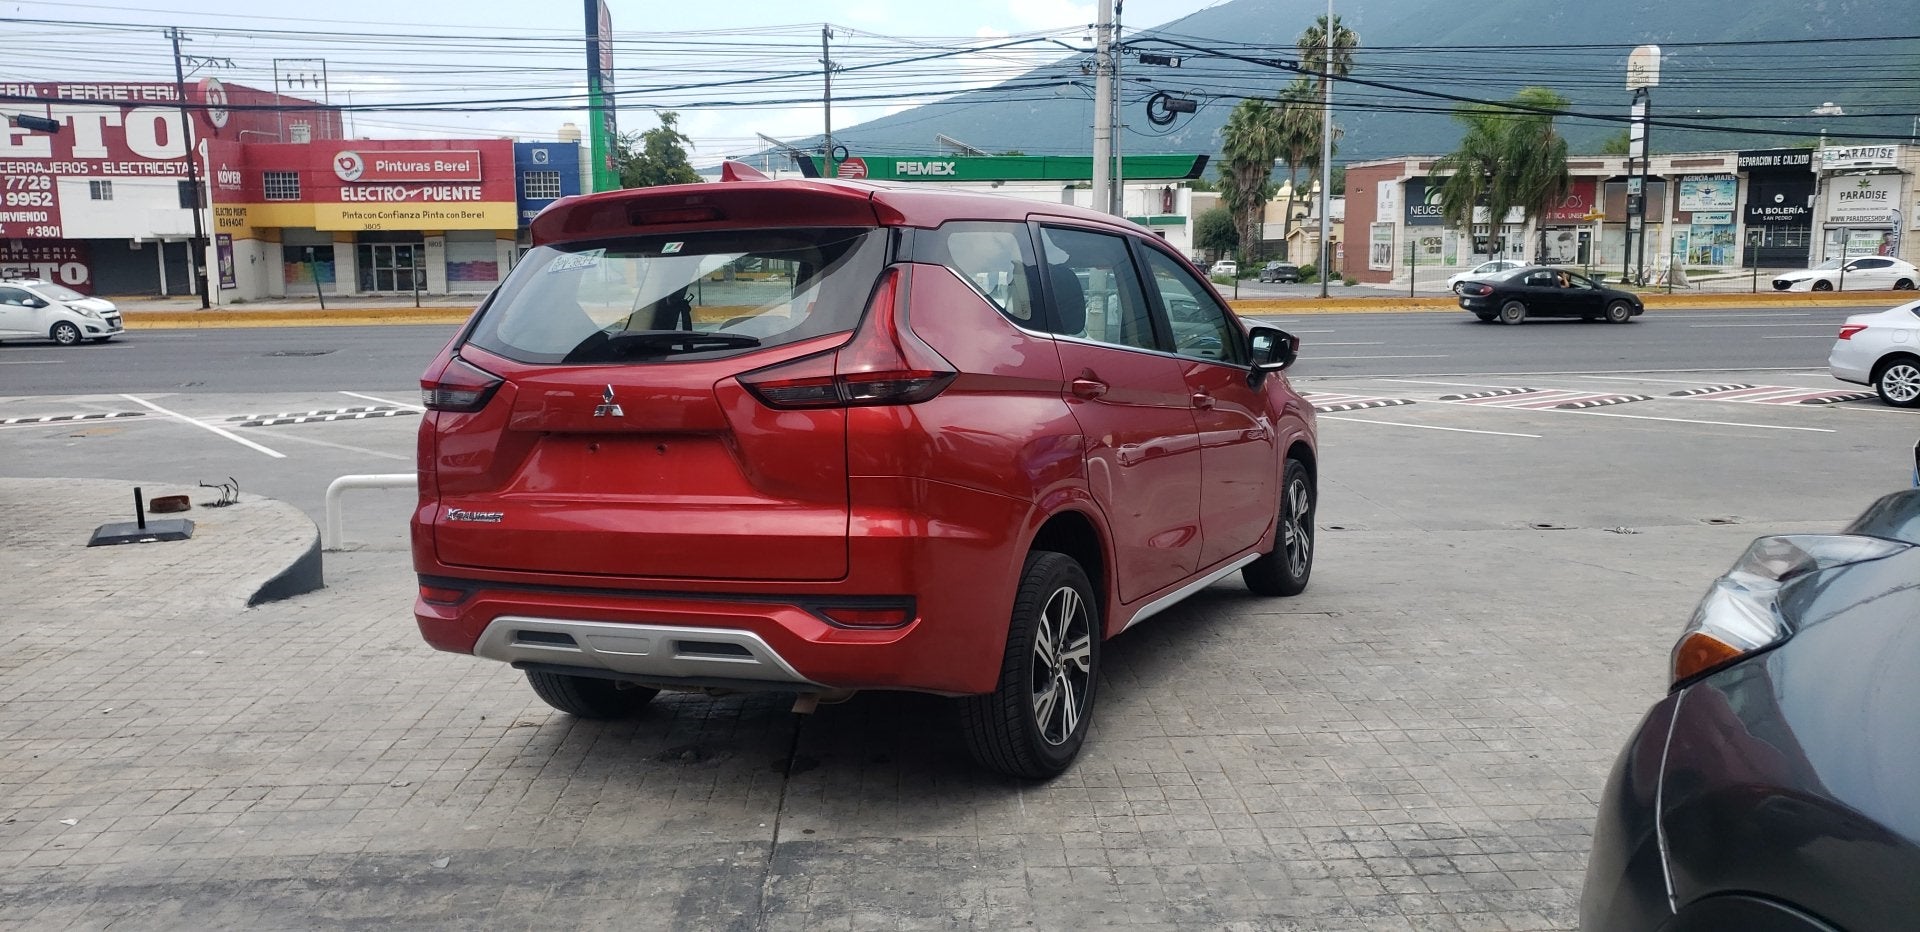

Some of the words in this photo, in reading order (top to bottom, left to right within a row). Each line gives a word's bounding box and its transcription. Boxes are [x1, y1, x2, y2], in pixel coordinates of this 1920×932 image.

[375, 160, 431, 173] Pinturas
[434, 160, 470, 172] Berel
[1738, 155, 1773, 167] REPARACION
[1773, 155, 1782, 166] DE
[1783, 154, 1810, 165] CALZADO
[0, 161, 88, 174] CERRAJEROS
[103, 161, 199, 174] ELECTRICISTAS
[896, 161, 956, 176] PEMEX
[4, 175, 52, 190] 7728
[6, 191, 54, 207] 9952
[340, 186, 407, 202] ELECTRO
[423, 186, 482, 201] PUENTE
[1840, 190, 1888, 200] PARADISE
[342, 211, 363, 219] Pinta
[378, 211, 421, 219] Confianza
[422, 211, 445, 219] Pinta
[461, 211, 485, 219] Berel
[1751, 207, 1763, 215] LA
[1765, 205, 1805, 215] BOLERÍA
[26, 225, 60, 237] #3801
